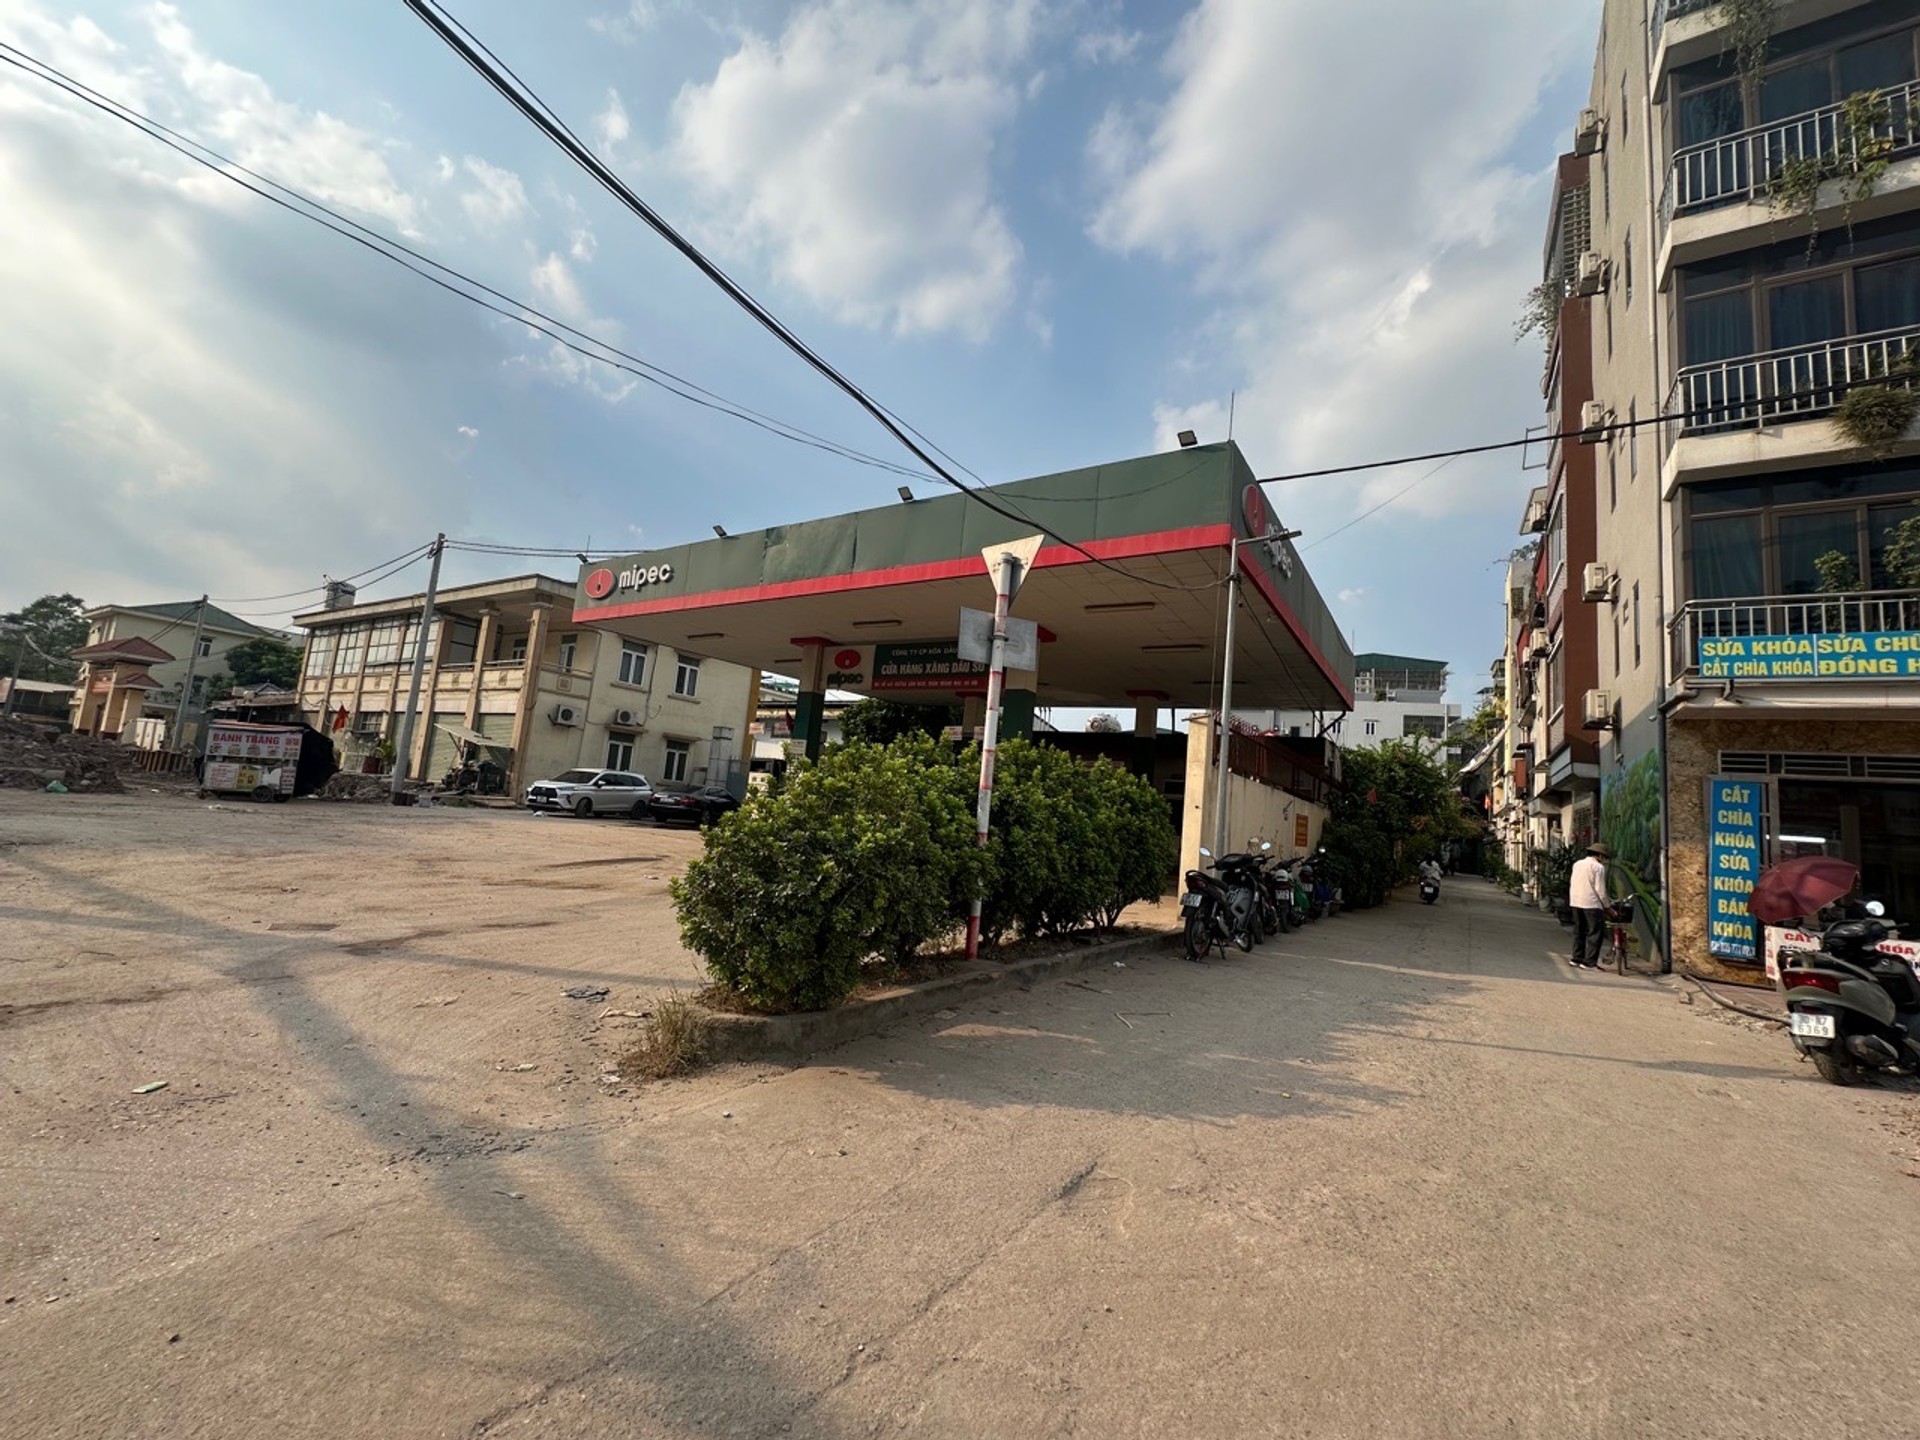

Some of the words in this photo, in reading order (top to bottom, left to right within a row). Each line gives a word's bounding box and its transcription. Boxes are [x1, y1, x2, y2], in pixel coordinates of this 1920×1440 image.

[619, 563, 671, 591] mipec
[1703, 637, 1745, 656] SỬA
[1752, 637, 1813, 655] KHÓA
[1817, 634, 1867, 654] SỬA
[900, 661, 923, 675] HÀNG
[1734, 658, 1768, 676] CHÌA
[1773, 658, 1813, 675] KHÓA
[1819, 655, 1898, 674] ĐỒNG
[1718, 809, 1753, 826] CHÌA
[1714, 831, 1755, 849] KHÓA
[1719, 849, 1750, 871] SỬA
[1714, 876, 1754, 894] KHÓA
[1713, 921, 1753, 940] KHÓA
